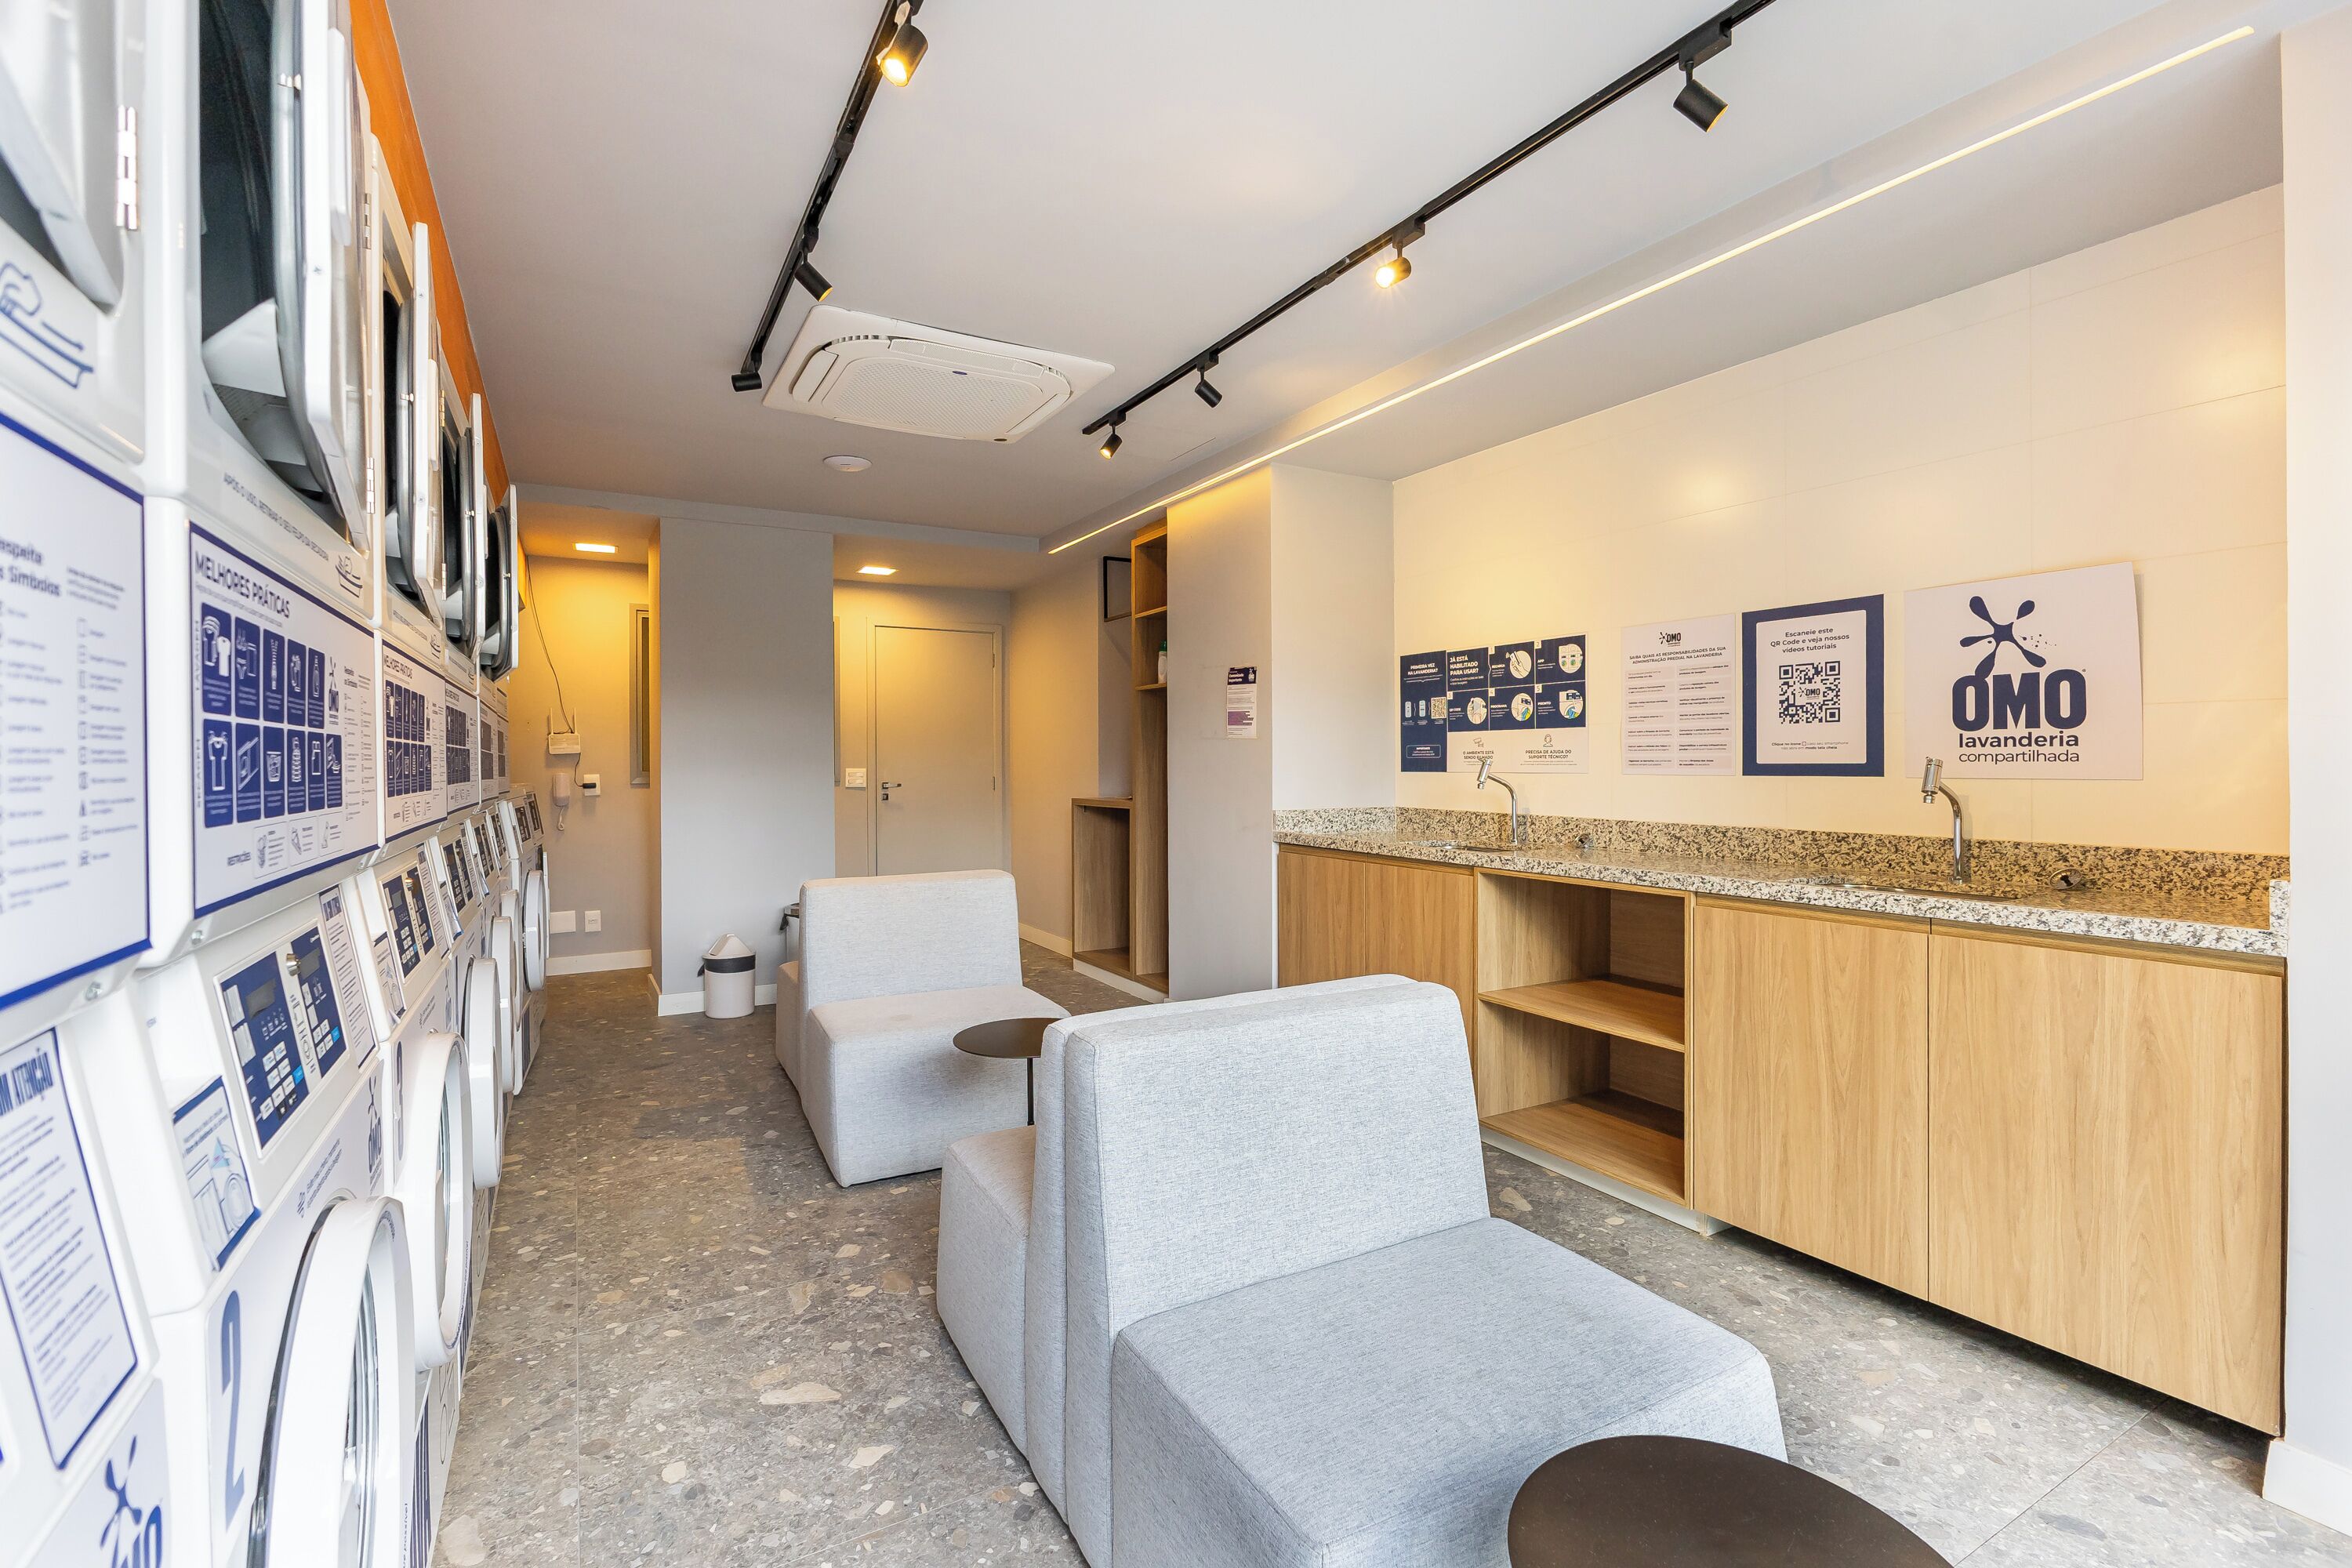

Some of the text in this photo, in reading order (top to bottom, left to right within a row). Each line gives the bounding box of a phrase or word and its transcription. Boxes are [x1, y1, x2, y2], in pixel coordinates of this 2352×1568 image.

[195, 551, 251, 599] MELHORES
[252, 584, 290, 619] PRÁTICAS
[1666, 632, 1681, 642] OMO
[1785, 630, 1816, 638] Escaneie
[1952, 669, 2087, 731] OMO
[1959, 731, 2079, 748] lavanderia
[1959, 750, 2079, 765] compartilhada
[12, 1049, 53, 1106] ATENÇÃO
[221, 1290, 245, 1534] 2
